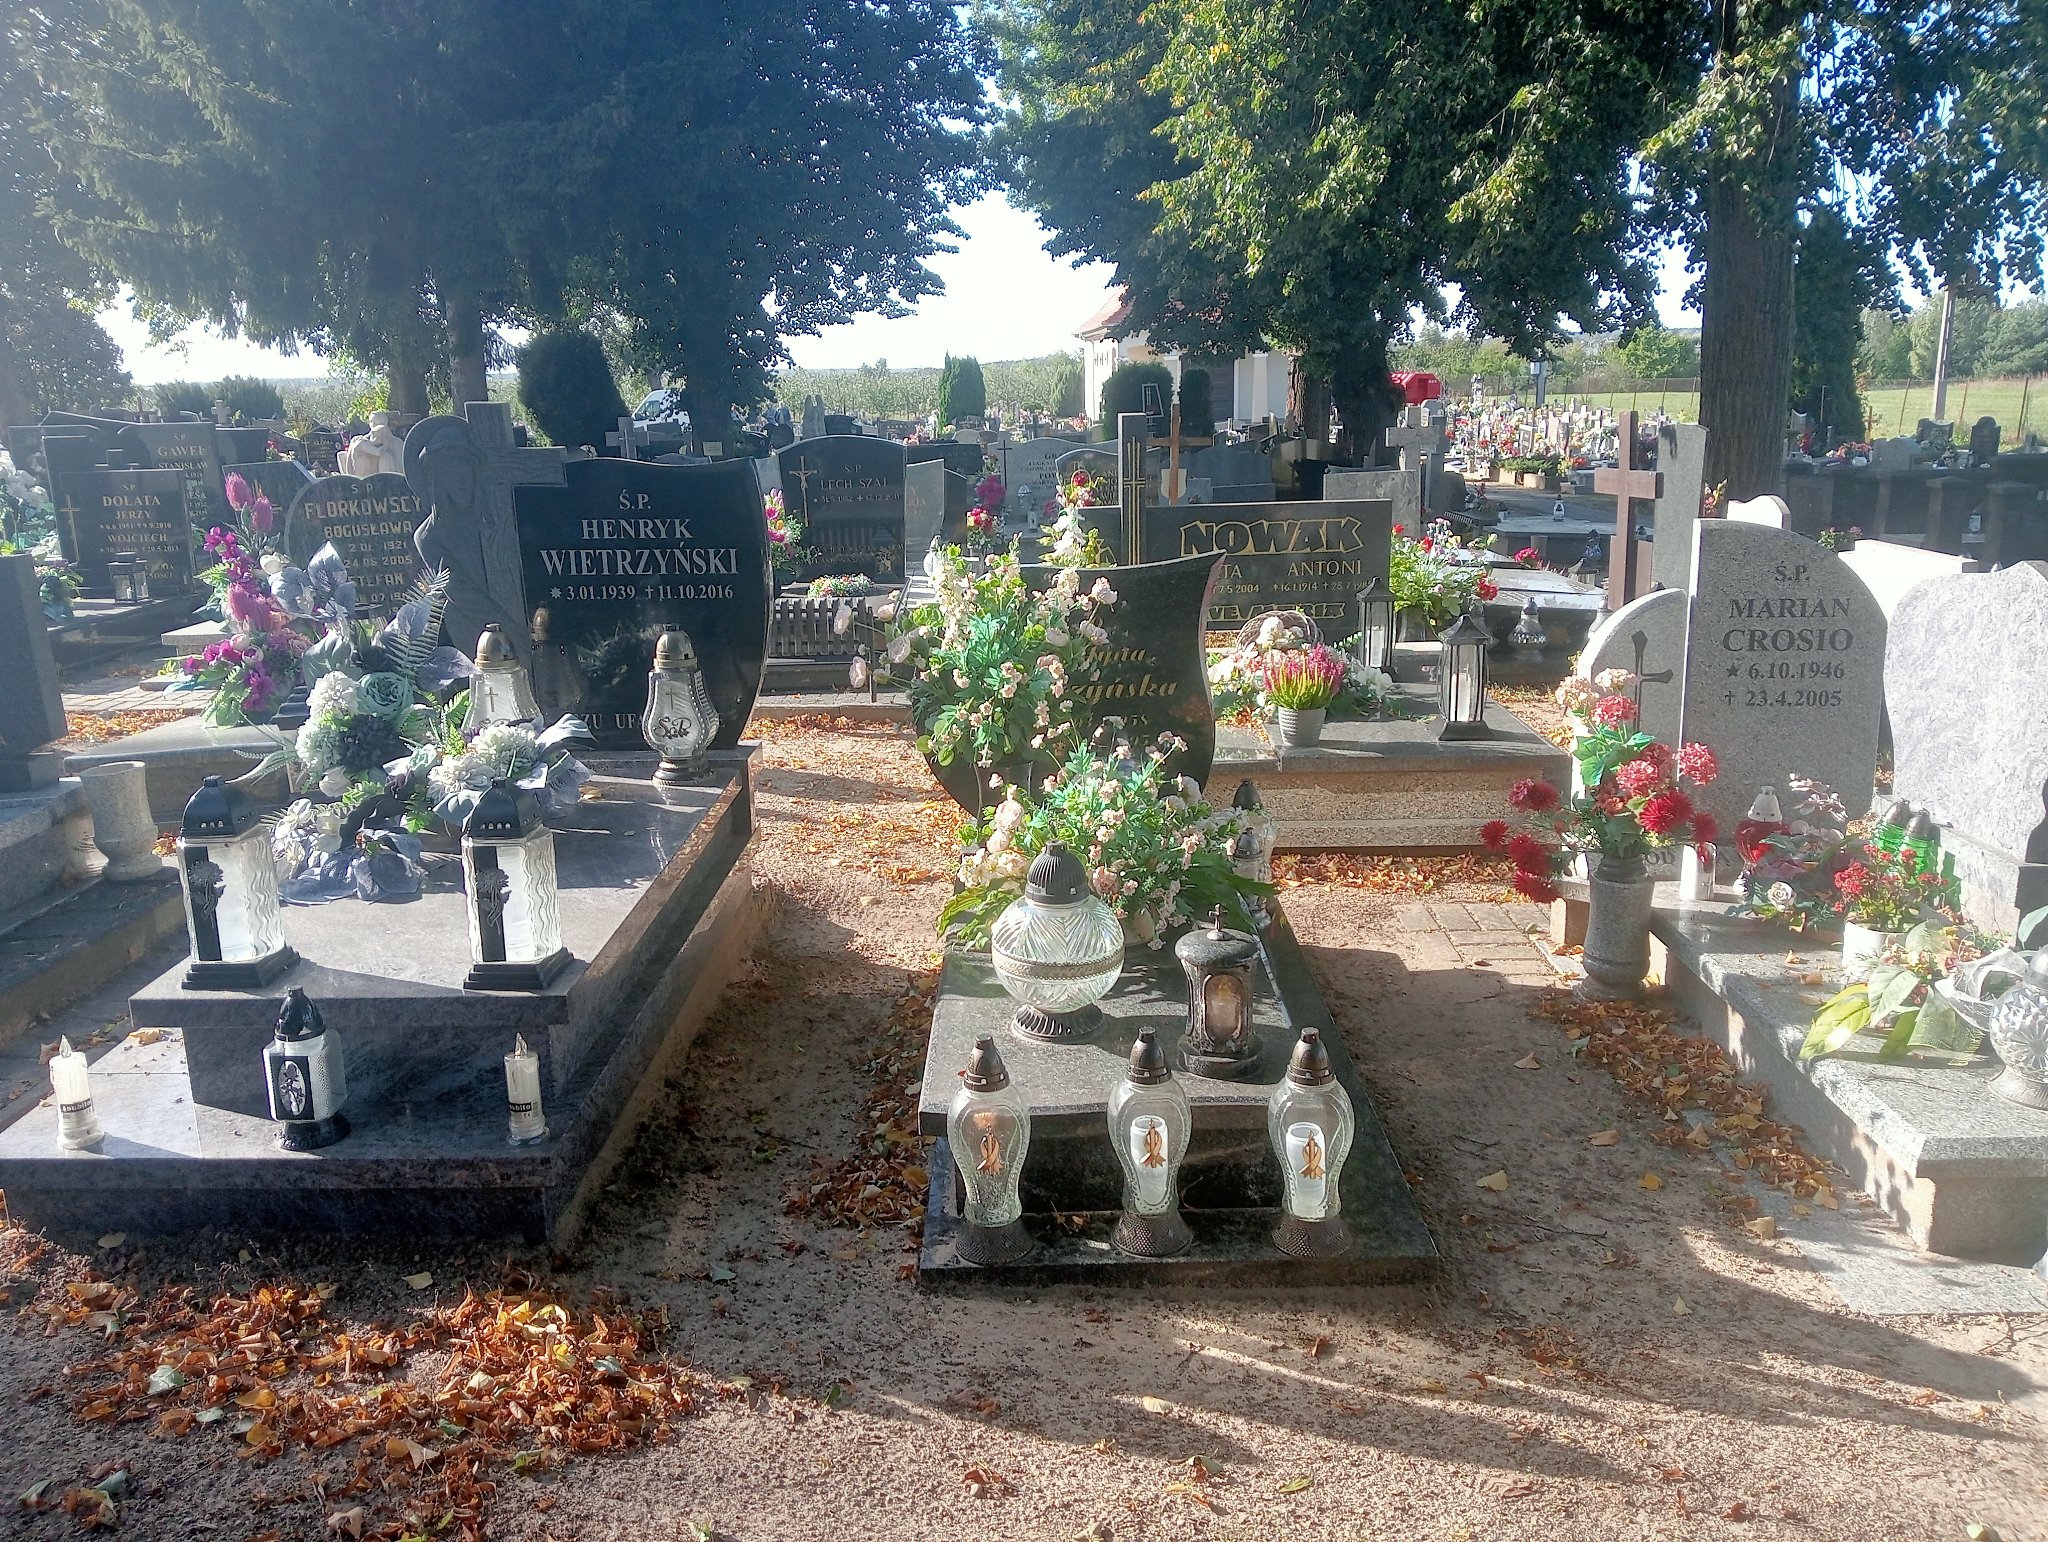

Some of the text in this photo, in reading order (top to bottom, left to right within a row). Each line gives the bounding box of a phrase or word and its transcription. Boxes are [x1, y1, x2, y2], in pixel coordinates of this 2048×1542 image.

[820, 479, 854, 491] LECH
[101, 495, 161, 507] DOLATA
[304, 496, 421, 520] FLORKOWSCY
[618, 489, 652, 510] Ś.P.
[115, 510, 152, 520] JERZY
[107, 533, 168, 543] WOJCIECH
[323, 520, 413, 539] BOGUSŁAWA
[581, 518, 694, 540] HENRYK
[1179, 515, 1364, 558] NOWAK
[540, 541, 740, 576] WIETRZYŃSKI
[1287, 559, 1362, 578] ANTONI
[1774, 560, 1811, 582] Ś.P.
[566, 583, 735, 601] 3.01.1939 11.10.2016
[1728, 597, 1851, 619] MARIAN
[1722, 628, 1854, 652] CROSIO
[1748, 661, 1846, 680] 6.10.1946
[1745, 690, 1842, 707] 23.4.2005
